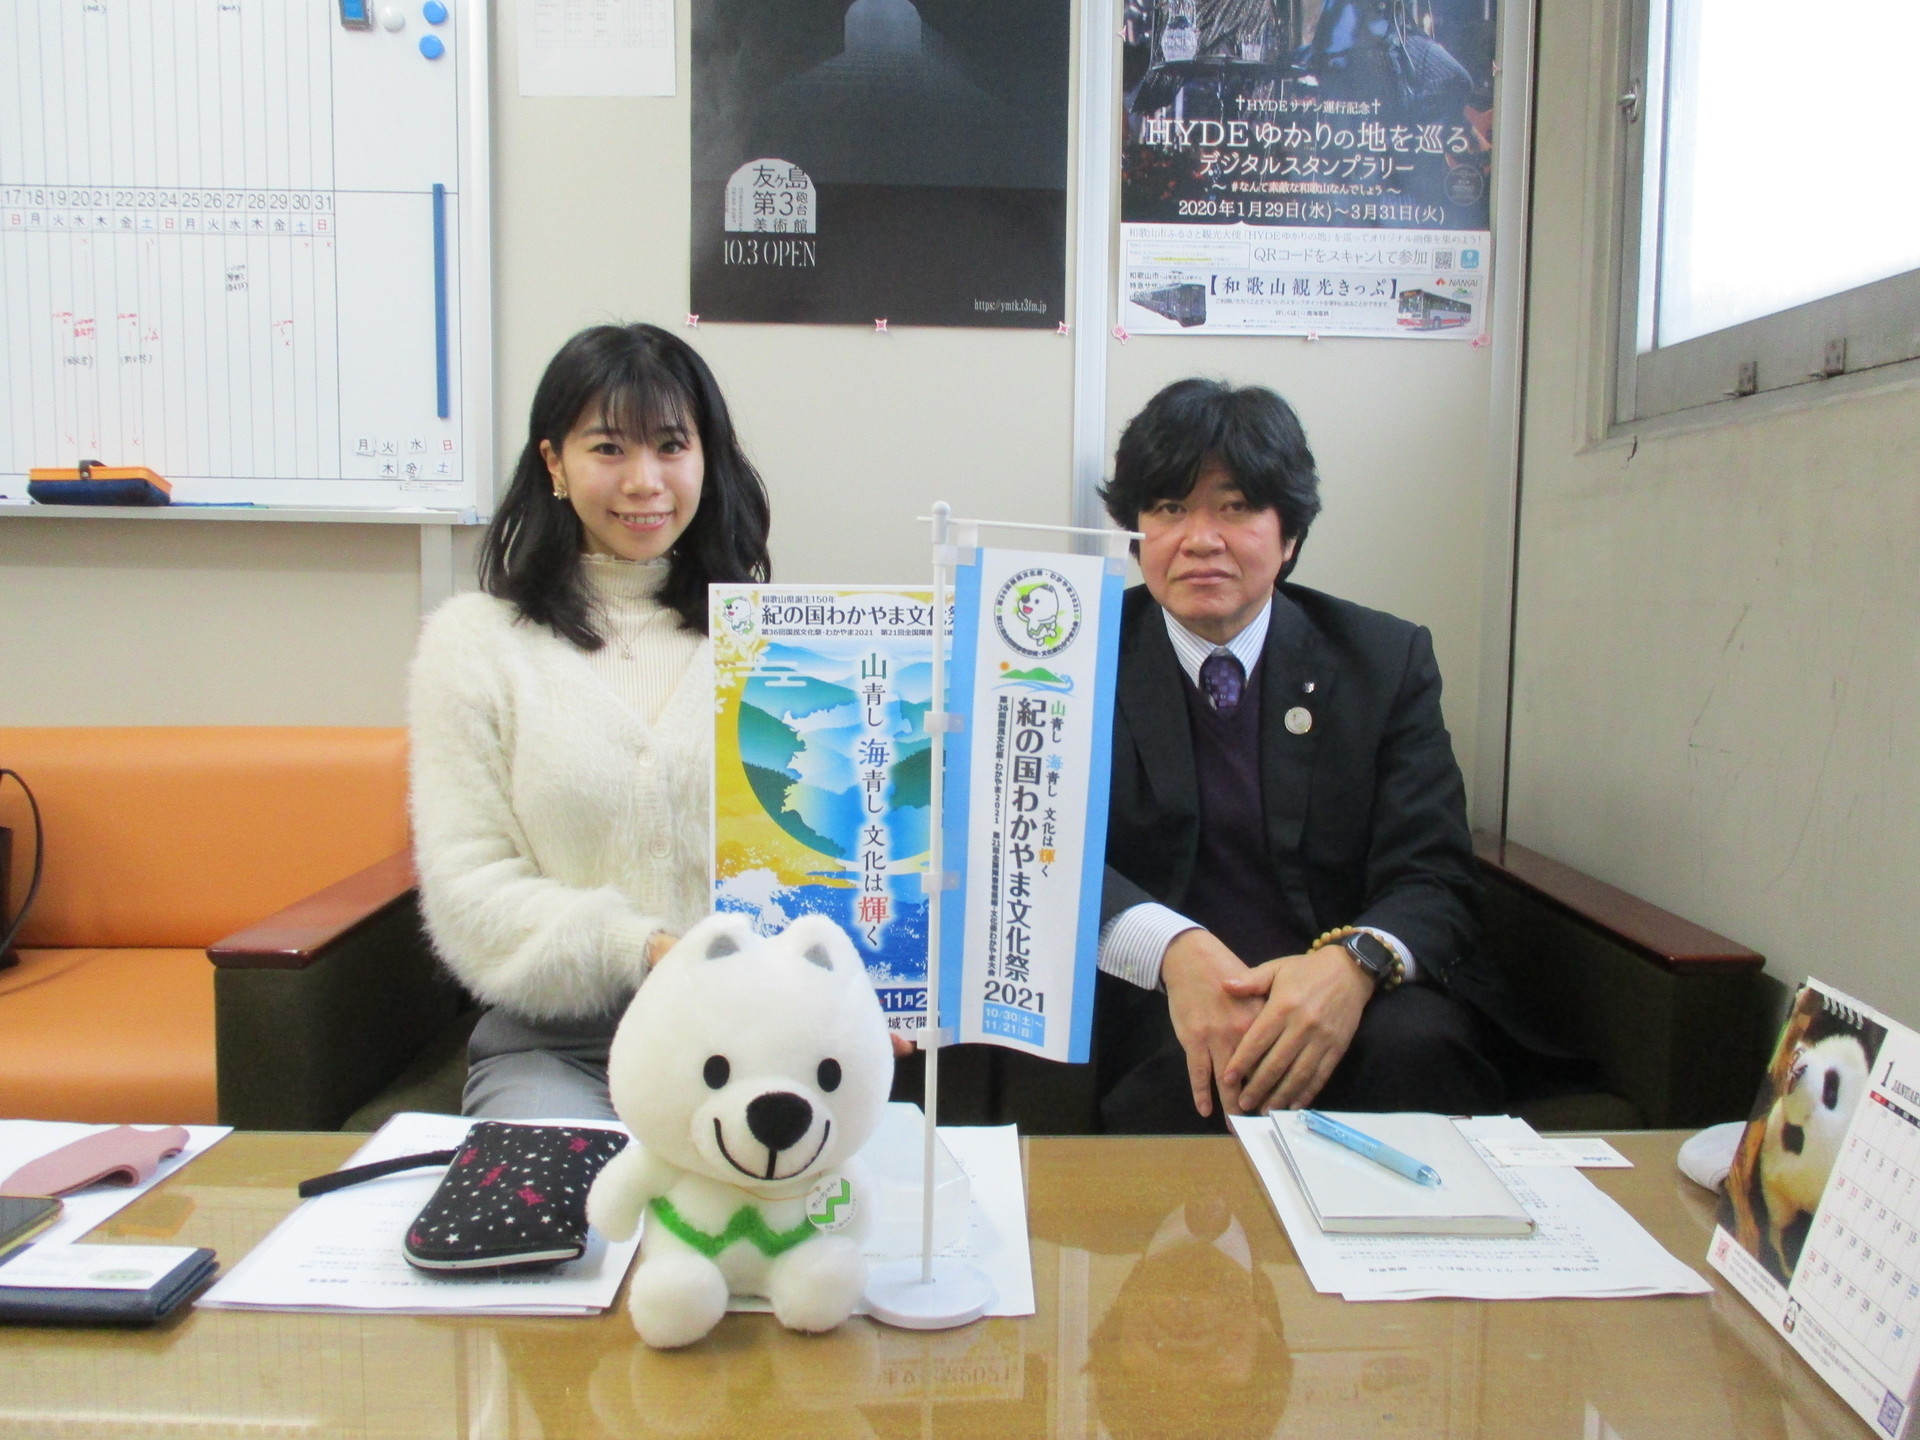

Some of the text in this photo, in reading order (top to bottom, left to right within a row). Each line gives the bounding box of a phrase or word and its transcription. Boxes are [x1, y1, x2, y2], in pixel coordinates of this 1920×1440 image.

[1146, 119, 1469, 153] HYDEゆかりの地を巡る
[1200, 151, 1414, 180] デジタルスタンプラリー
[4, 190, 332, 210] 17 18 19 20 21 22 23 24 25 26 27 28 29 30 31
[12, 213, 327, 232] 日 月 火 水 木 金 土 日 月 火 水 木 金 土 日
[724, 239, 816, 267] 10.3 OPEN
[1254, 247, 1428, 266] QRコードをスキャンして参加
[359, 438, 453, 453] 月 火 水 日
[382, 461, 449, 475] 木 金 土
[1050, 700, 1066, 743] 山青し
[1045, 754, 1063, 797] 海青し
[857, 652, 890, 946] 山青し 海青し 文化は輝く
[1005, 697, 1047, 983] 紀の国わかやま文化祭
[984, 980, 1044, 1013] 2021
[1881, 1060, 1895, 1088] 1
